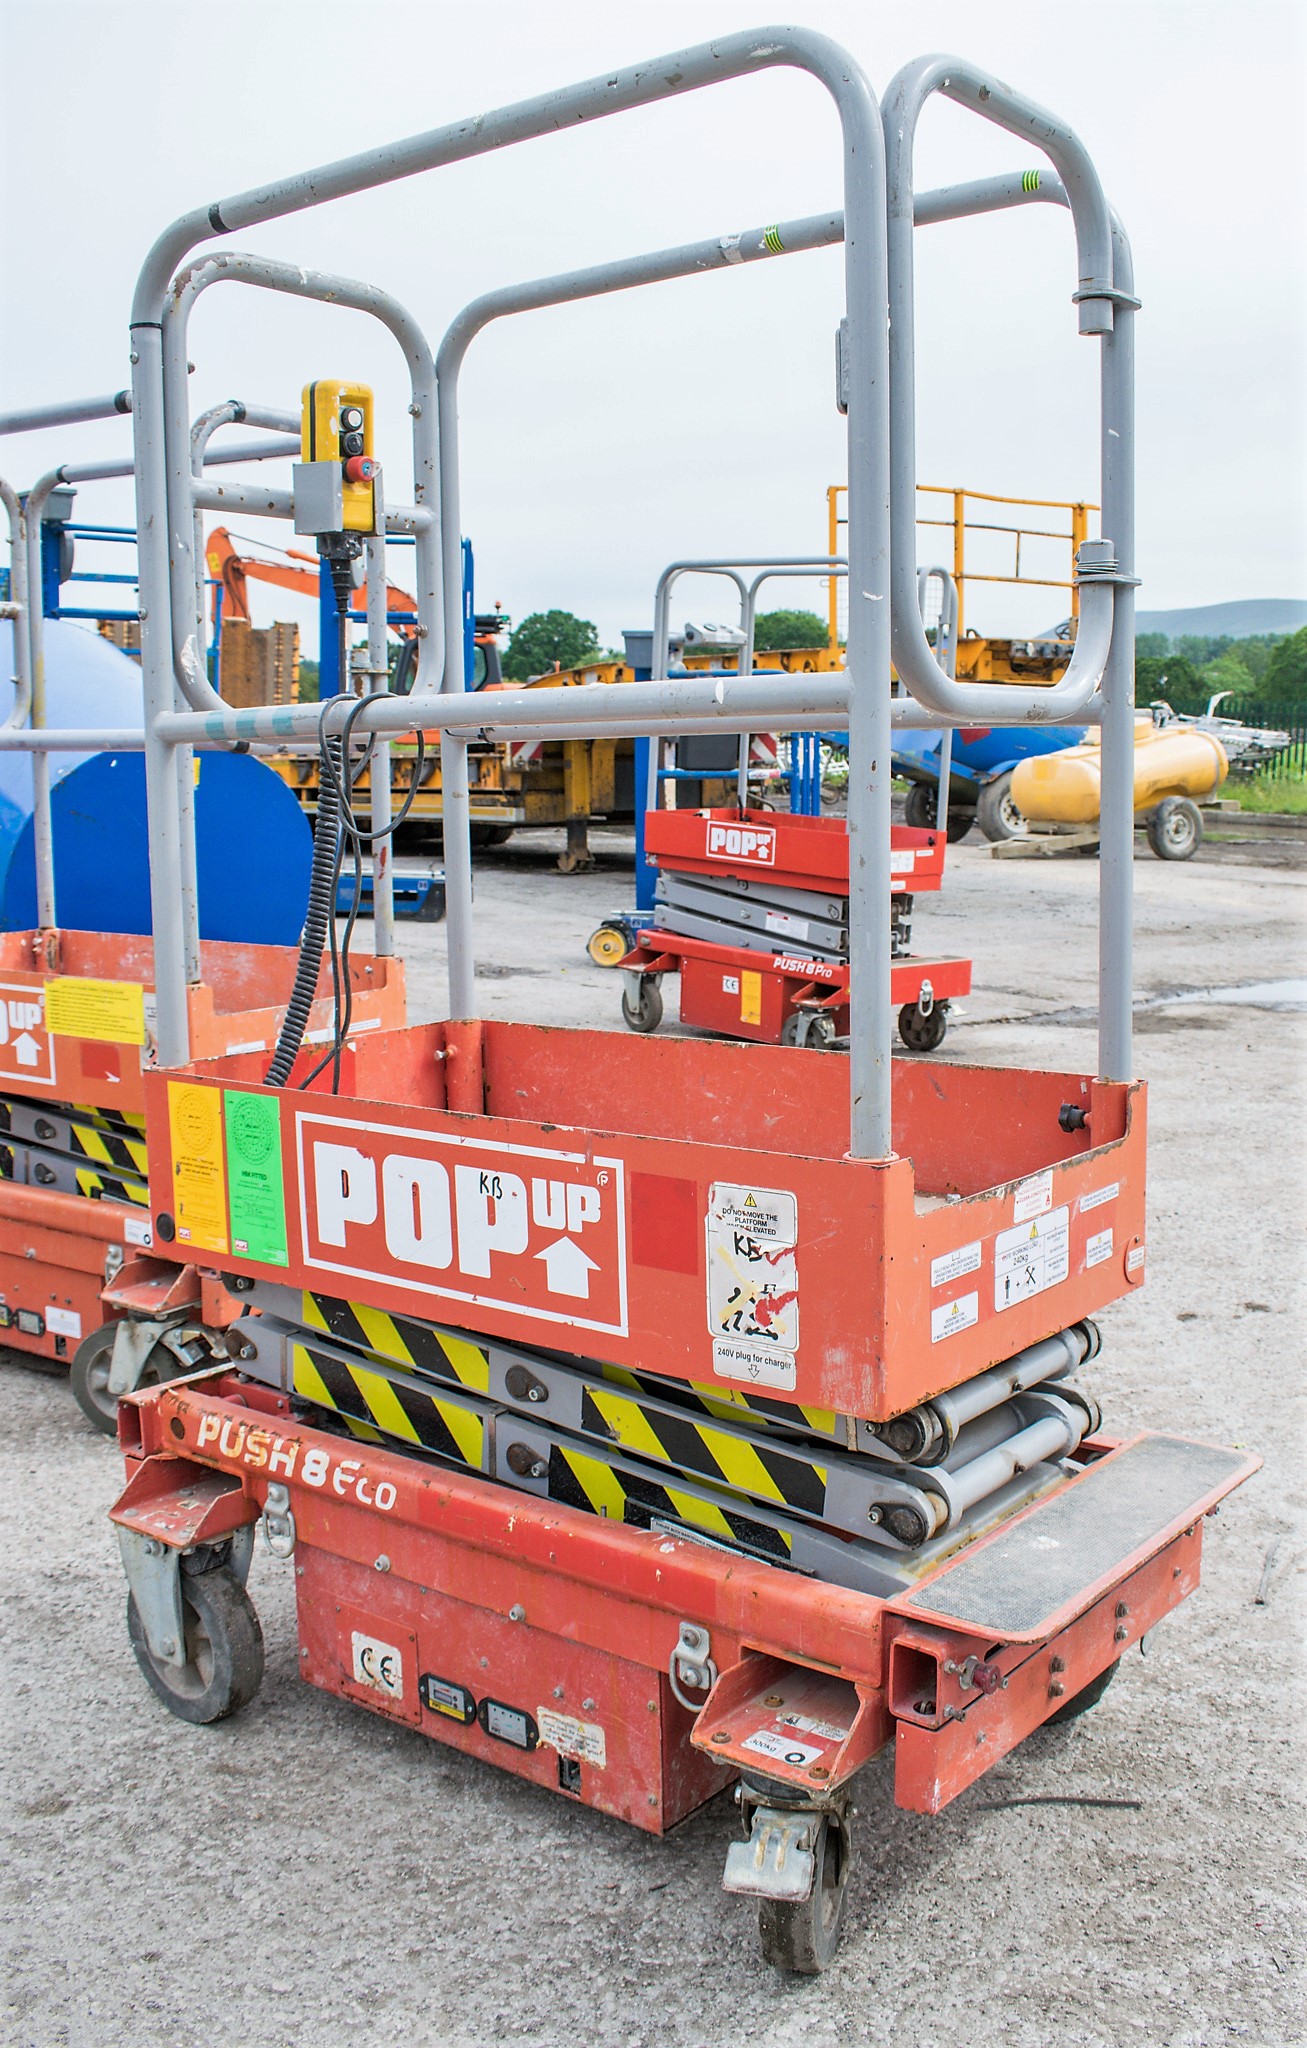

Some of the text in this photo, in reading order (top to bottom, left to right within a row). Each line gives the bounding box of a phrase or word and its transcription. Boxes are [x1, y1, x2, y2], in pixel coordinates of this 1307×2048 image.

[710, 827, 757, 856] POP
[773, 957, 805, 974] PUSH
[7, 1000, 42, 1031] UP
[313, 1140, 529, 1279] POP
[531, 1177, 601, 1233] UP
[722, 1207, 732, 1215] DO
[747, 1211, 765, 1220] MOVE
[765, 1213, 778, 1222] THE
[734, 1216, 768, 1227] PLATFORM
[717, 1347, 792, 1370] 240V plug for charger
[196, 1414, 301, 1478] PUSH
[360, 1647, 395, 1689] CE
